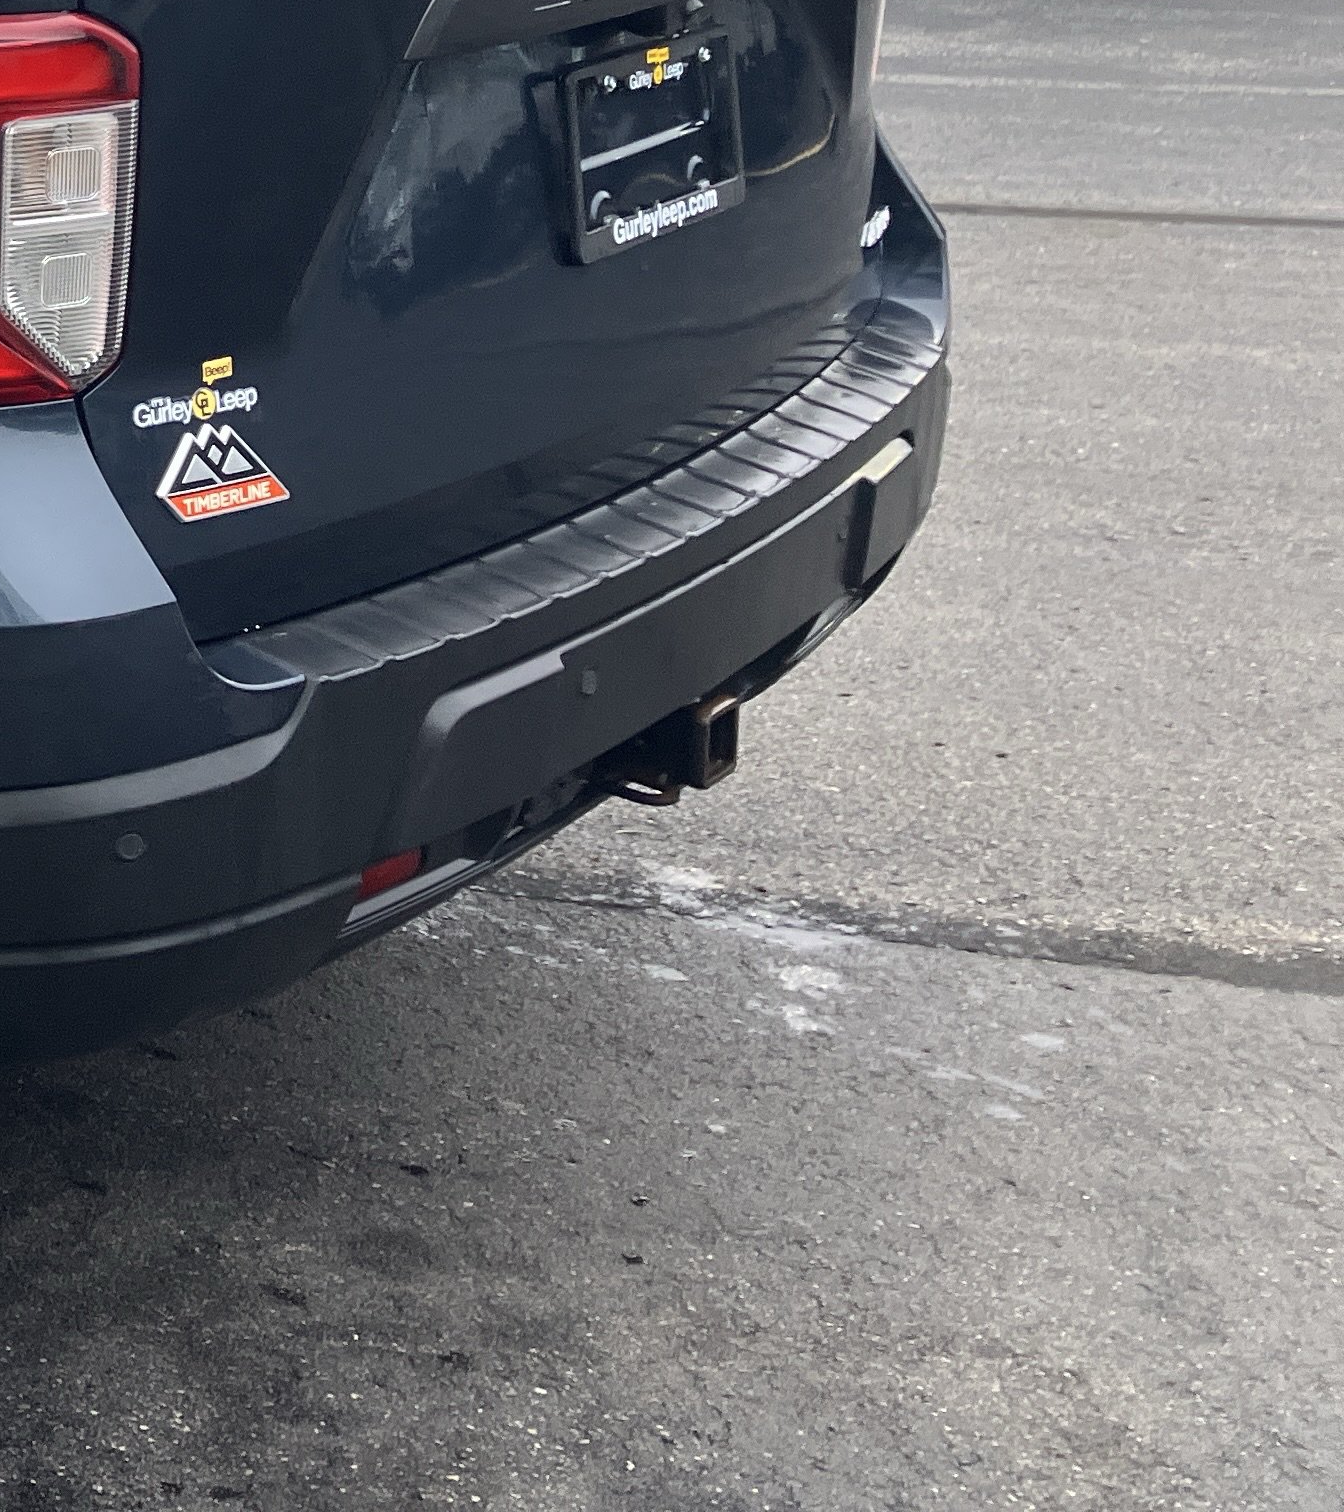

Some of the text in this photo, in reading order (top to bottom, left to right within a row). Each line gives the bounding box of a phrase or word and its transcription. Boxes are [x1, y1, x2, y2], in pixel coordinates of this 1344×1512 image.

[613, 188, 718, 245] Gurleyleep.com
[132, 395, 193, 428] Gurley
[215, 386, 258, 413] Leep
[182, 480, 272, 516] TIMBERLINE
